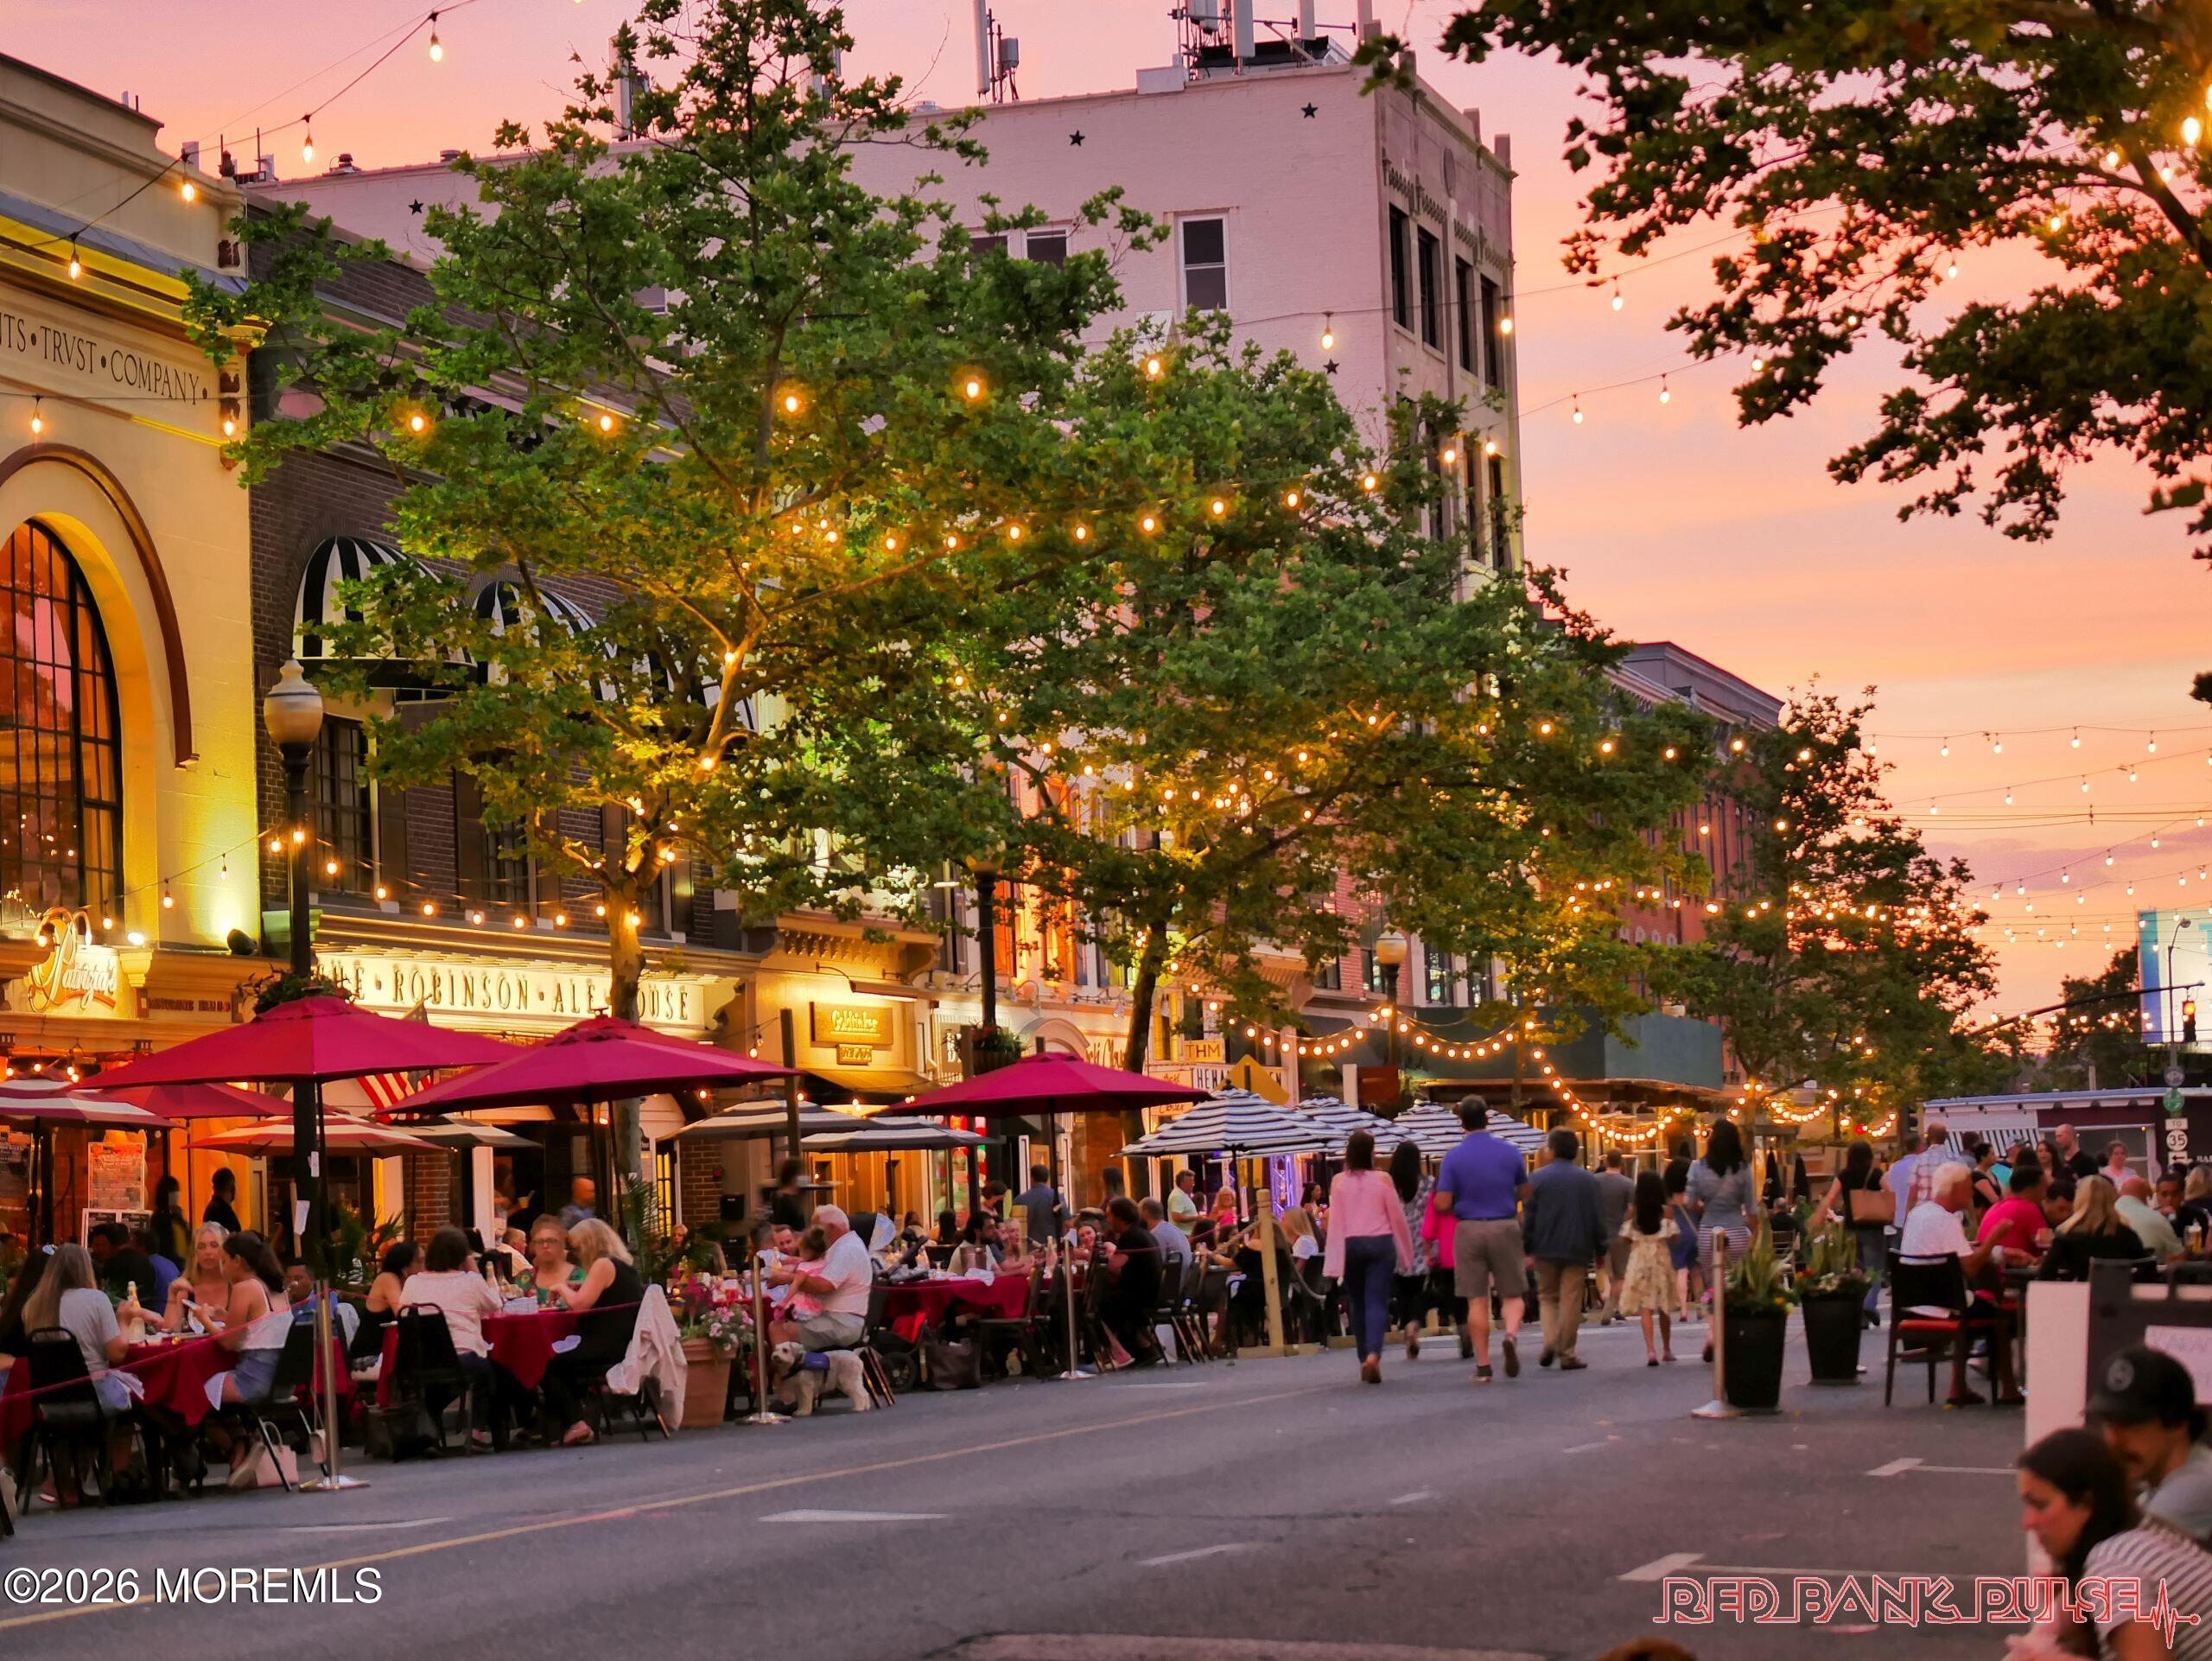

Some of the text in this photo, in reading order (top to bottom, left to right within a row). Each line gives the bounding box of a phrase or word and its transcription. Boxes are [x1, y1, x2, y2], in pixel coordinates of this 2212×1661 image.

[0, 312, 26, 353] TS
[111, 349, 200, 405] COMPANY
[391, 967, 529, 1010] ROBINSON
[552, 979, 597, 1014] ALE
[1185, 1043, 1221, 1059] THM
[2169, 1134, 2186, 1146] 35
